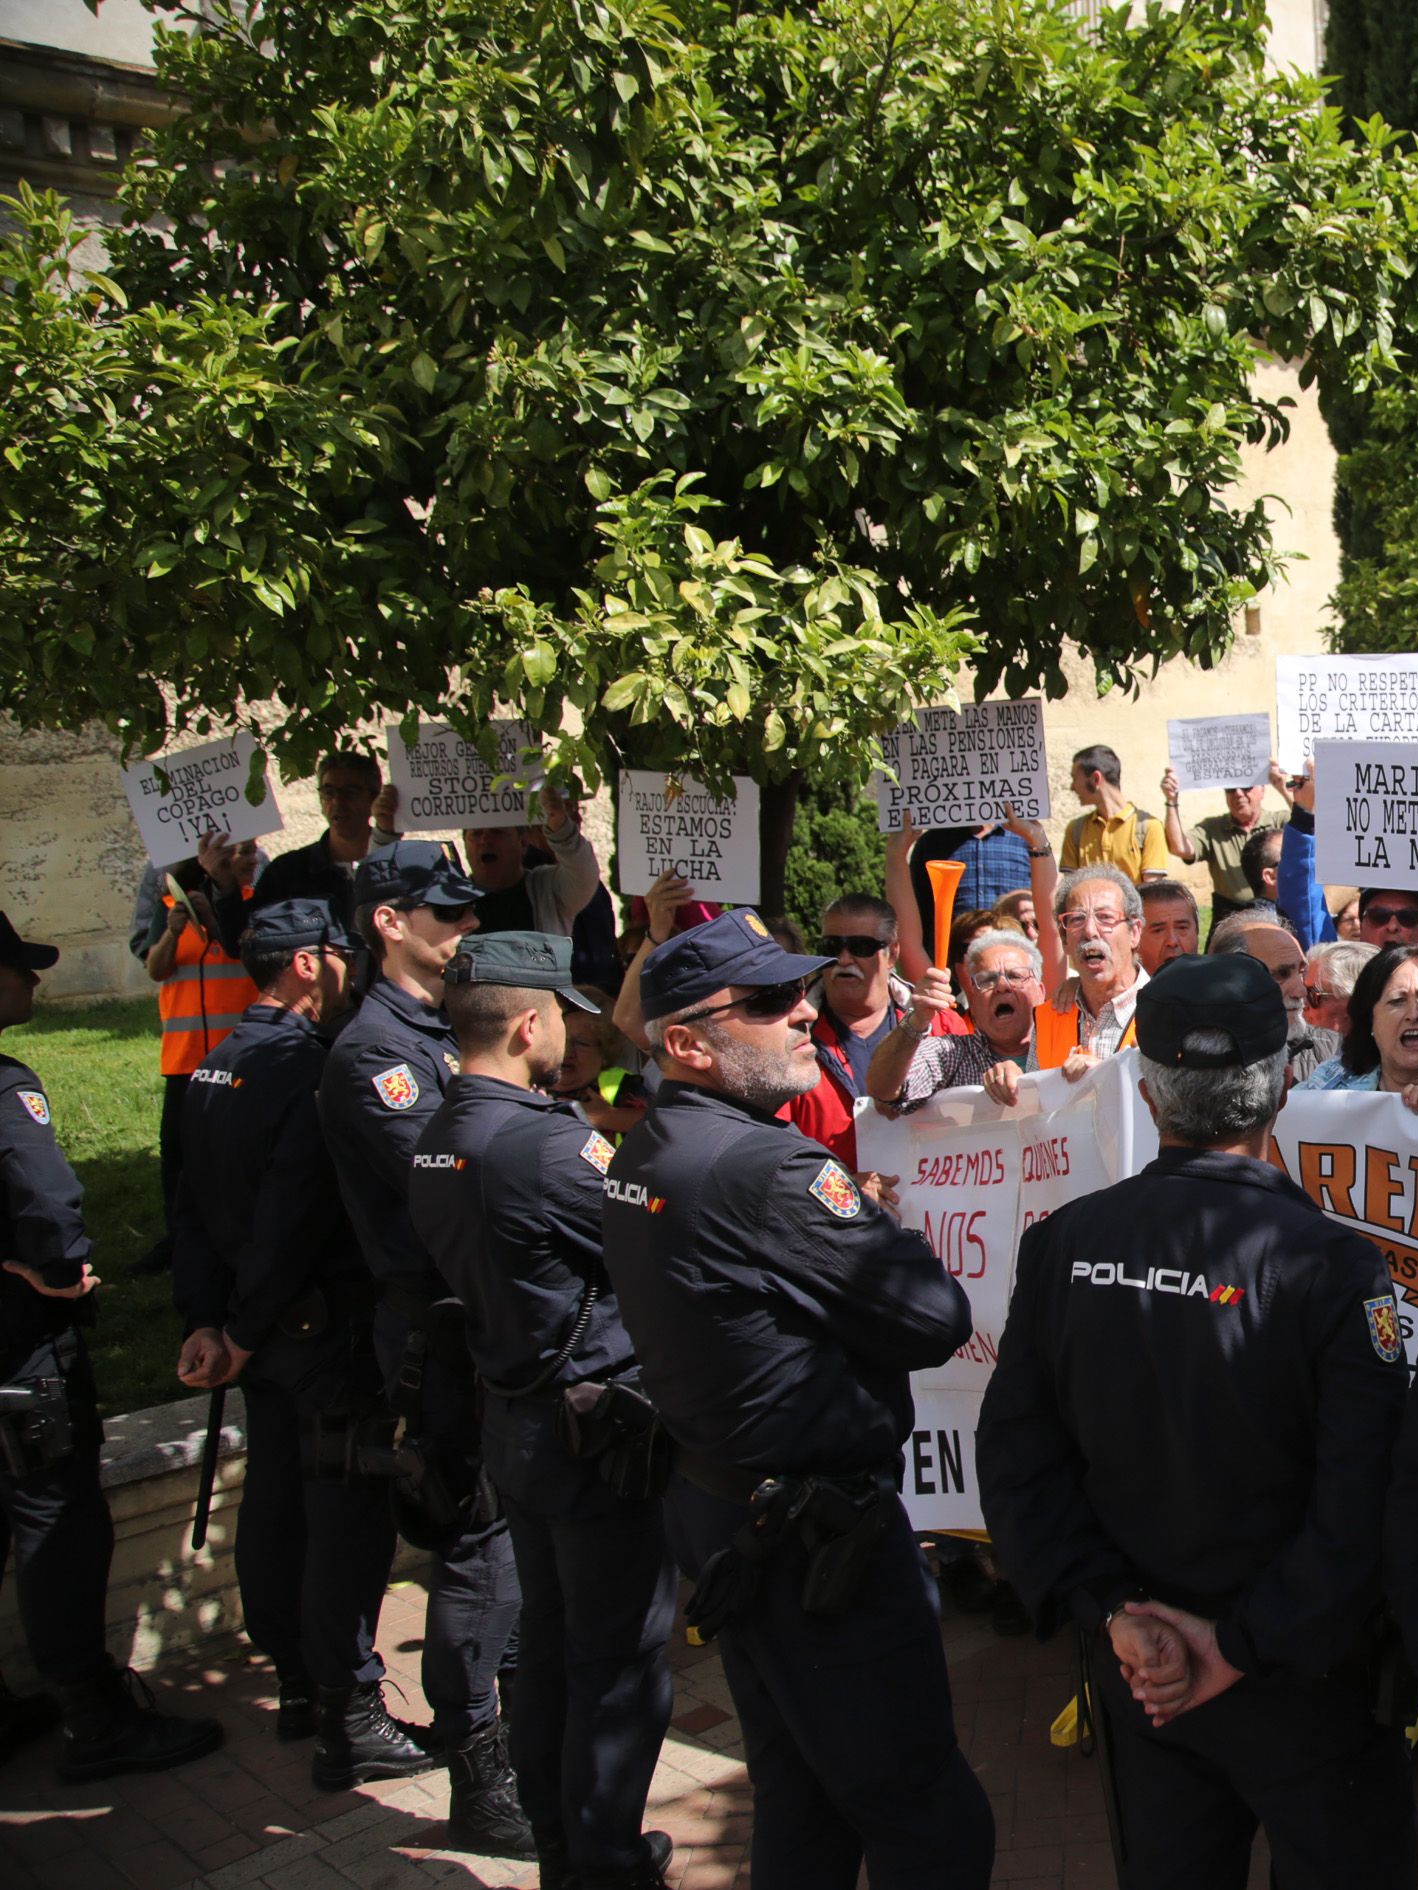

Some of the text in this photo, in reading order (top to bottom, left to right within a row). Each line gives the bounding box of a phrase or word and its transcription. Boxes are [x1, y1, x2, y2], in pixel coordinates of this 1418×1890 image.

[1299, 673, 1317, 691] PP
[1328, 673, 1348, 691] NO
[1299, 693, 1327, 711] LOS
[924, 711, 956, 732] METE
[965, 707, 988, 729] LAS
[997, 704, 1037, 727] MANOS
[1299, 713, 1322, 733] DE
[1335, 713, 1358, 732] LA
[405, 742, 448, 760] MEJOR
[881, 736, 899, 759] EN
[909, 733, 937, 757] LAS
[140, 751, 240, 795] ELMINACIÓN
[911, 754, 969, 780] PAGARA
[980, 753, 998, 774] EN
[1010, 750, 1039, 773] LAS
[1193, 767, 1254, 781] ESTADO
[171, 778, 212, 802] DEL
[429, 776, 493, 795] STOP
[889, 777, 1032, 806] PRÓXIMAS
[157, 786, 239, 823] COPAGO
[411, 786, 524, 816] CORRUPCIÓN
[888, 799, 1039, 828] ELECCIONES
[640, 814, 731, 839] ESTAMOS
[1346, 797, 1370, 833] NO
[646, 837, 723, 858] EN LA
[1355, 835, 1391, 868] LA
[648, 857, 721, 881] LUCHA
[413, 1155, 455, 1168] POLICIA
[911, 1149, 1004, 1186] SABEMOS
[1071, 1262, 1209, 1299] POLICIA
